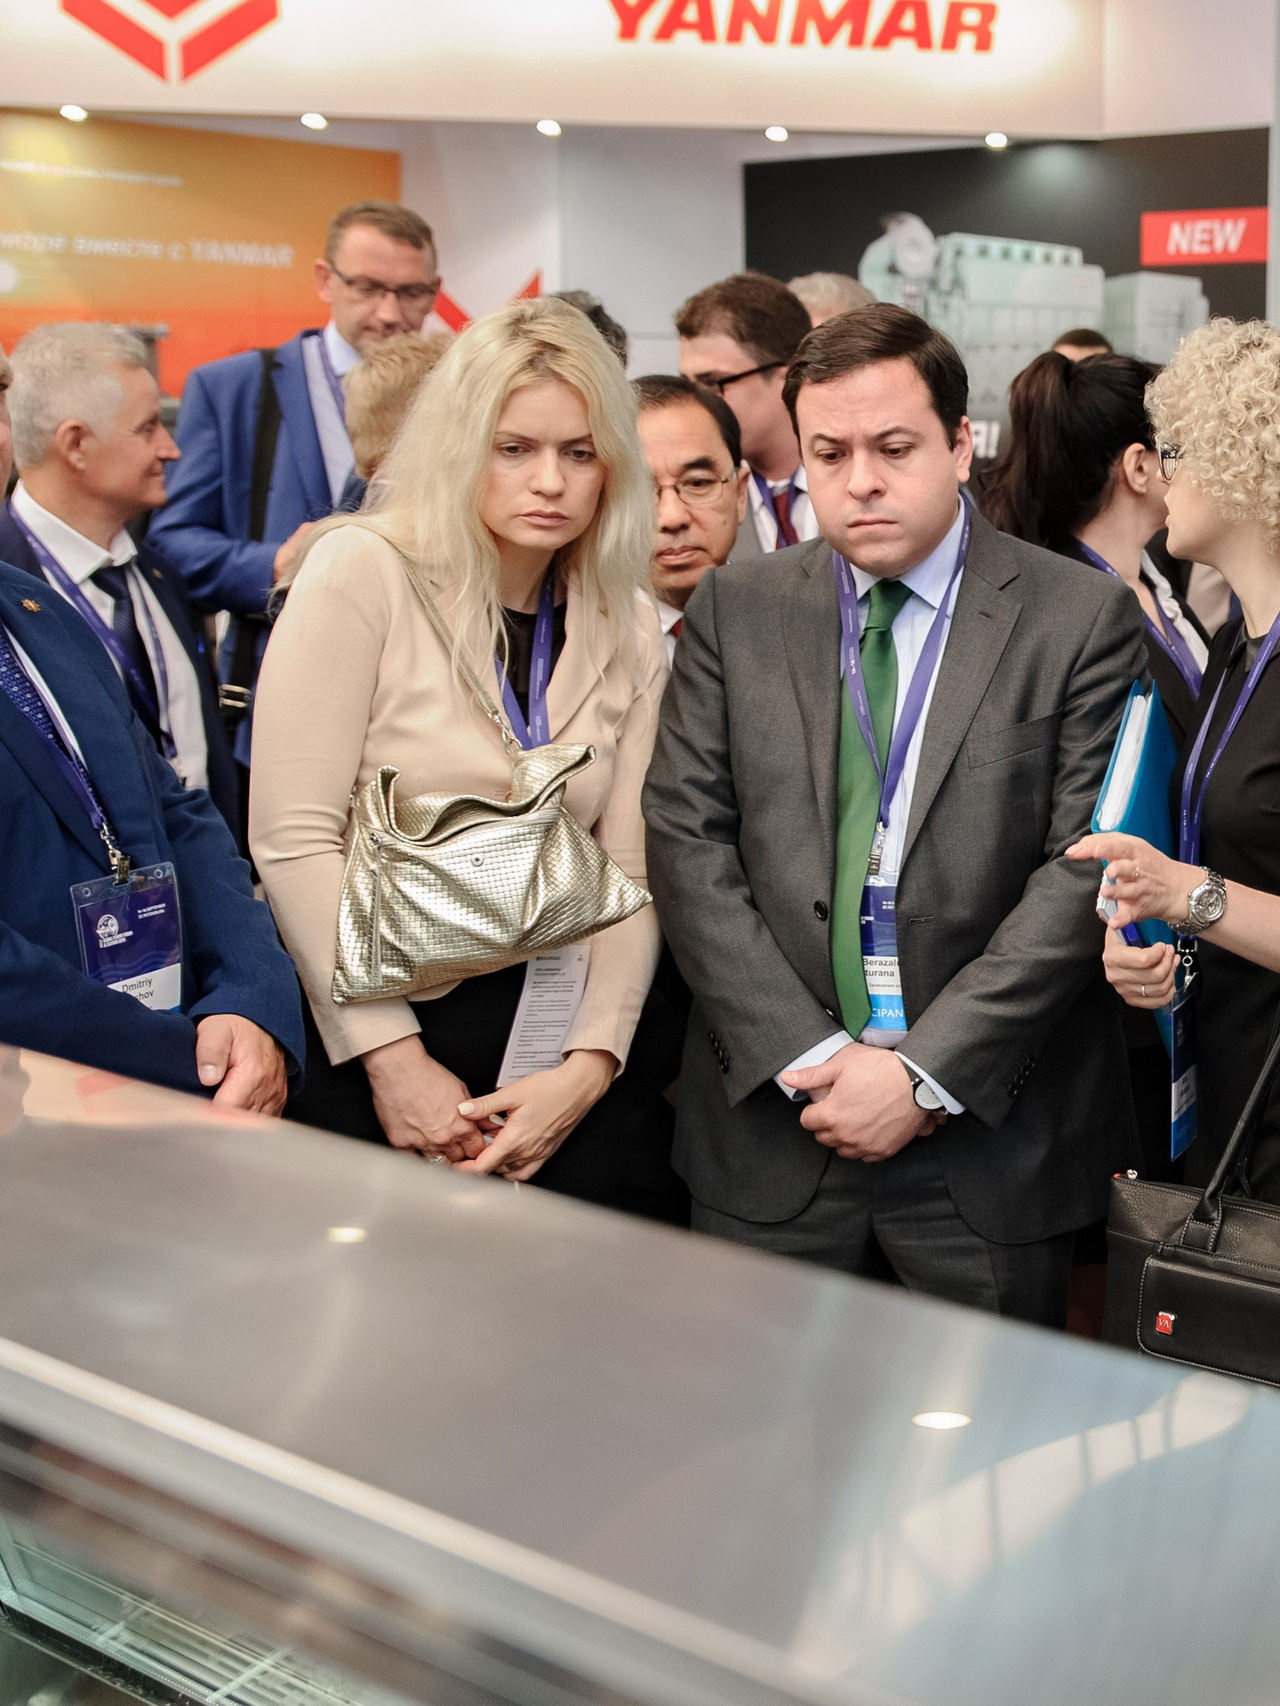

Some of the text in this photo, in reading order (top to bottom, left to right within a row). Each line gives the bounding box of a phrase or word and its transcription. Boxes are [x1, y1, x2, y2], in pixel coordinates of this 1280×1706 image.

[609, 0, 998, 53] YANMAR
[190, 239, 294, 268] YANMAR
[1166, 218, 1247, 256] NEW
[122, 977, 153, 993] Dmitriy
